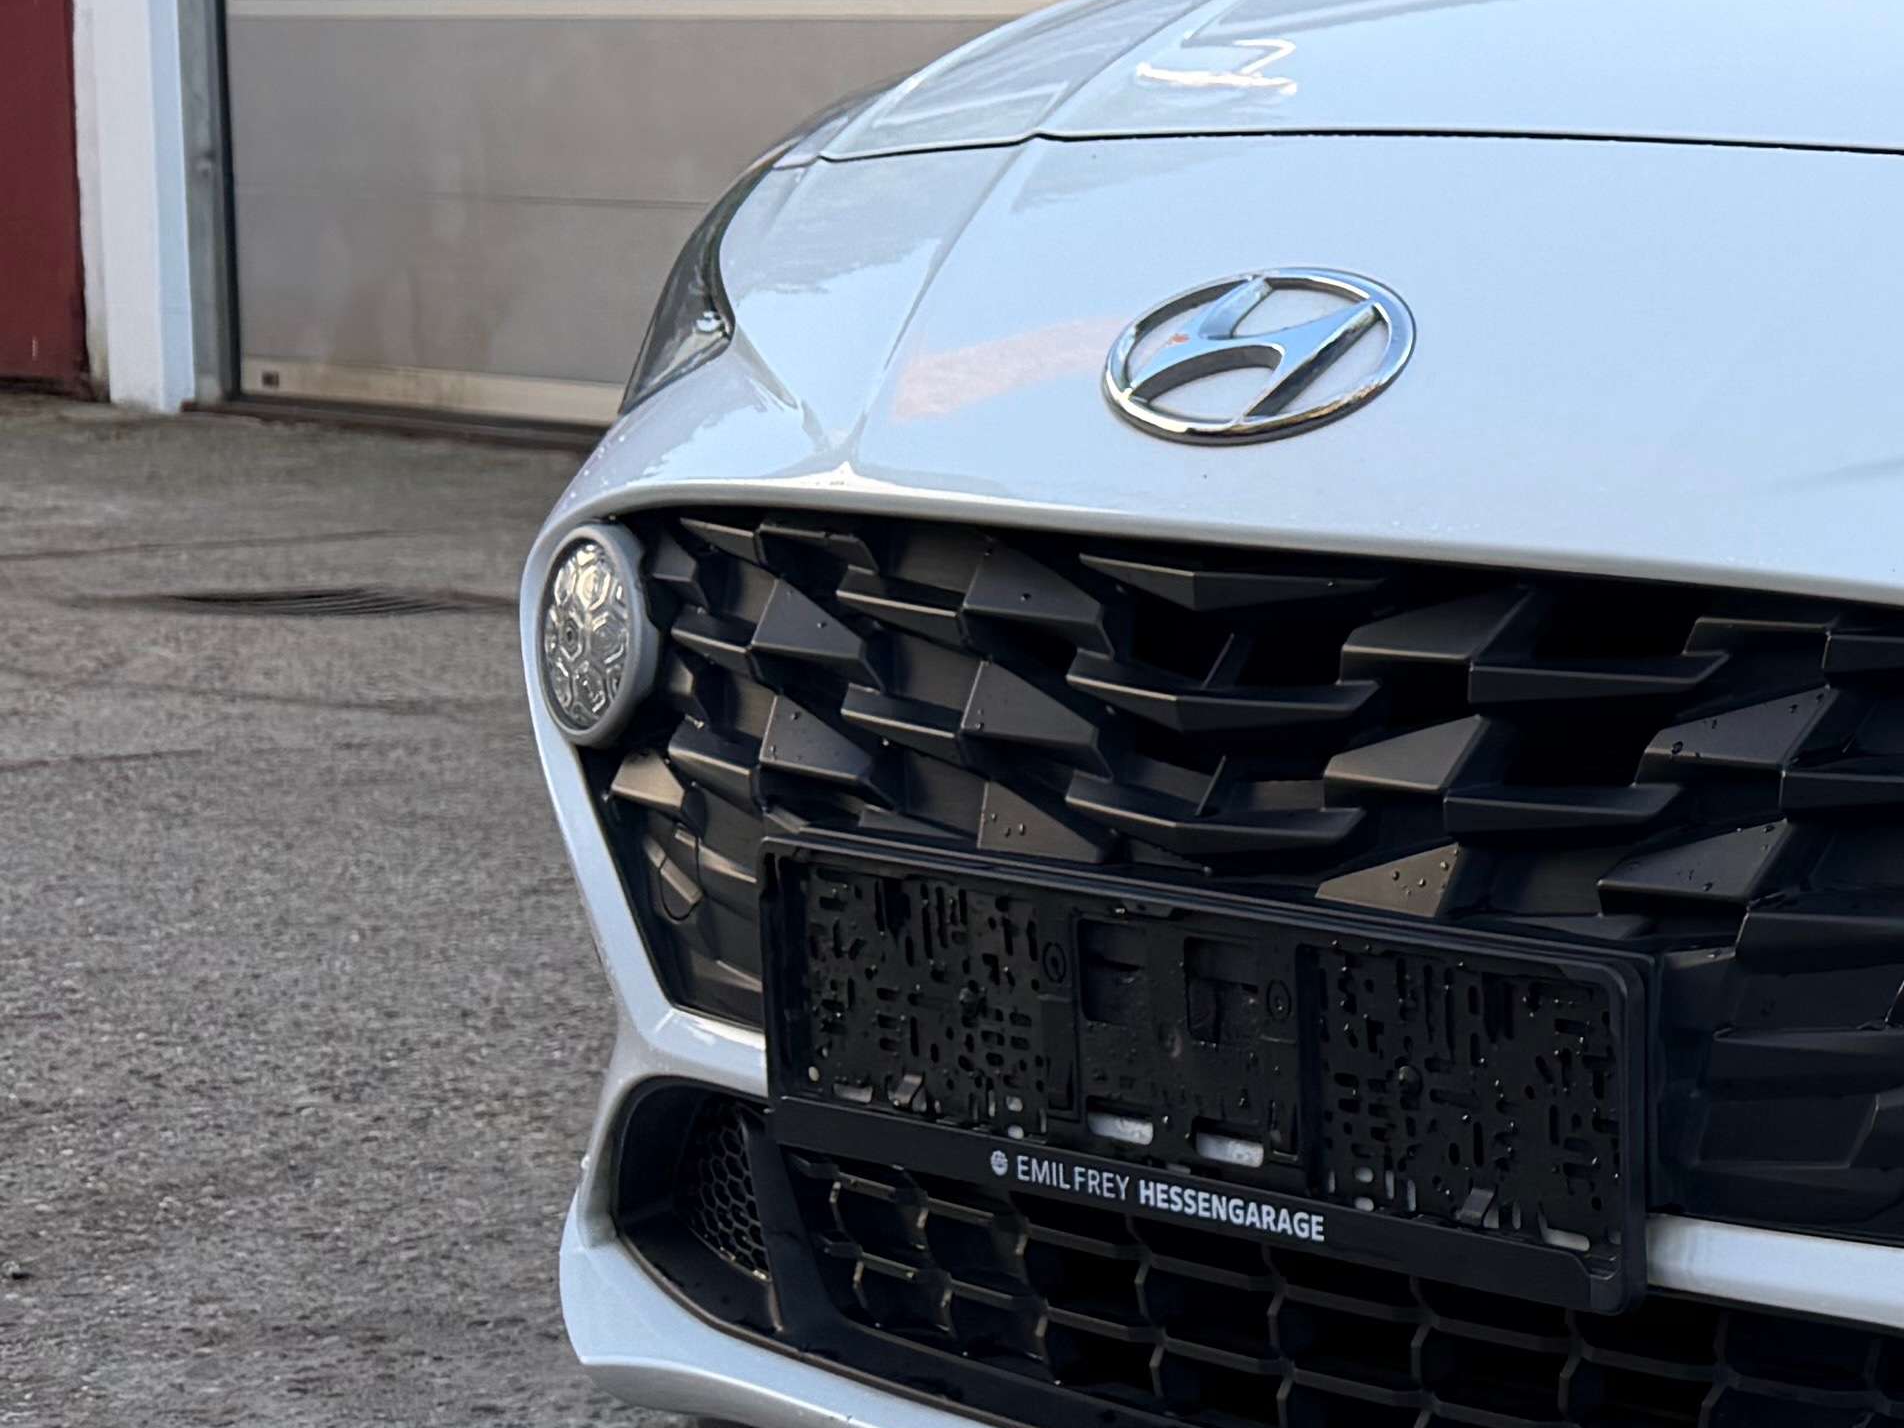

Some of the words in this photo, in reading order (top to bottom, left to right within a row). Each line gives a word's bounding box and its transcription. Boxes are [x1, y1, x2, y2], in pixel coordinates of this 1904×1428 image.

[1015, 1154, 1071, 1191] EMIL
[1073, 1165, 1130, 1201] FREY
[1138, 1178, 1326, 1243] HESSENGARAGE
